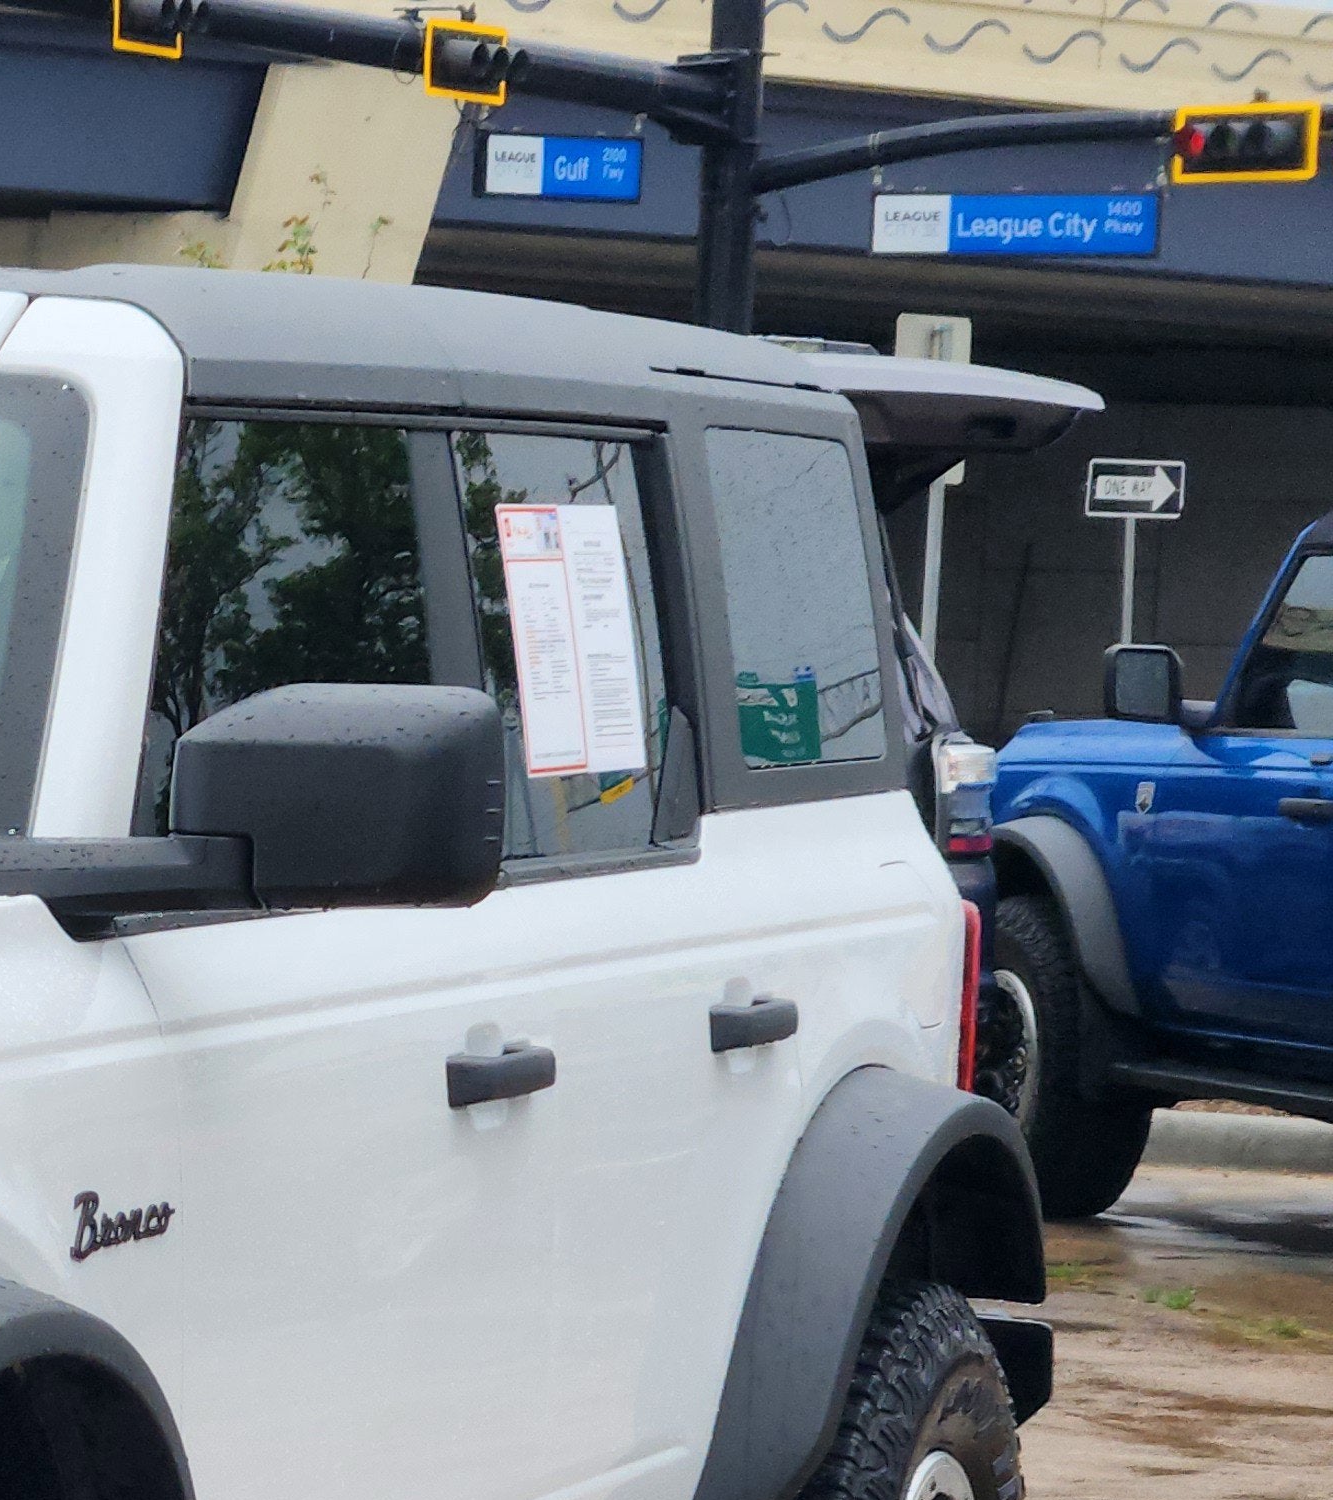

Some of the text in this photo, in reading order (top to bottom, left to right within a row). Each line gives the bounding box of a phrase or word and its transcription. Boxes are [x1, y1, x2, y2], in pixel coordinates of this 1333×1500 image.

[494, 150, 537, 163] LEAGUE
[553, 155, 590, 181] Gulf
[602, 164, 625, 182] Fwy
[884, 210, 941, 223] LEAGUE
[1106, 200, 1142, 217] 1400
[956, 212, 1043, 245] League
[1047, 211, 1098, 243] City
[1102, 219, 1144, 236] Pkwy
[1104, 478, 1127, 497] ONE
[69, 1190, 176, 1263] Bronco
